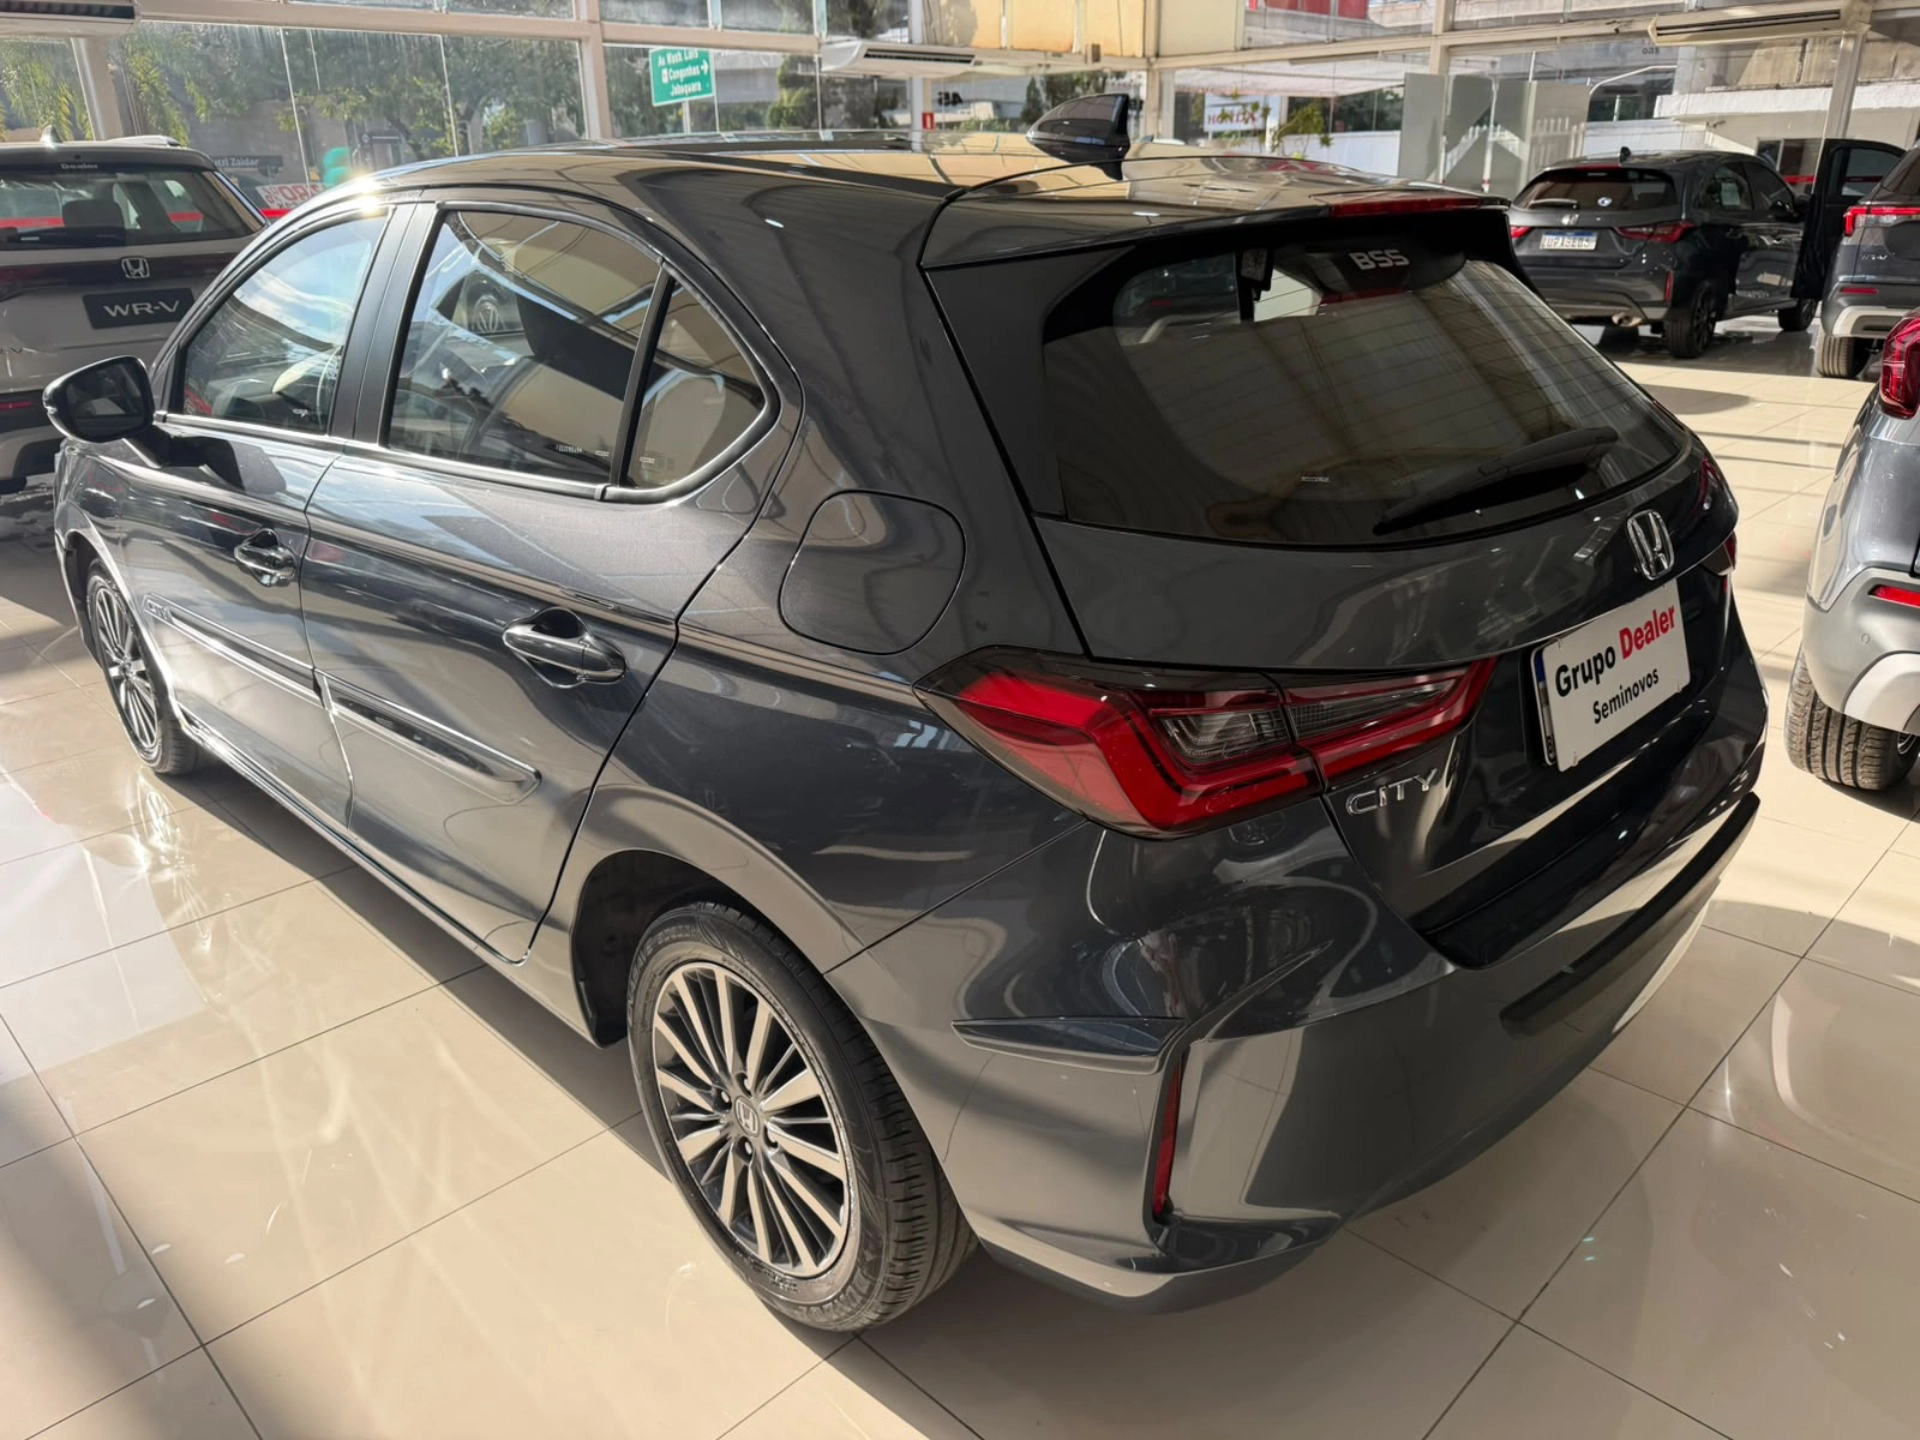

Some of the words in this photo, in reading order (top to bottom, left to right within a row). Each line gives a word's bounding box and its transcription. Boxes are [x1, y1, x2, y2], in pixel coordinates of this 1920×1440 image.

[669, 64, 700, 83] Congonhas
[1348, 248, 1410, 270] BSS
[103, 300, 180, 318] WR-V
[1555, 646, 1616, 698] Grupo
[1619, 605, 1676, 660] Dealer
[1593, 668, 1659, 725] Seminovos
[1345, 767, 1438, 816] CITY
